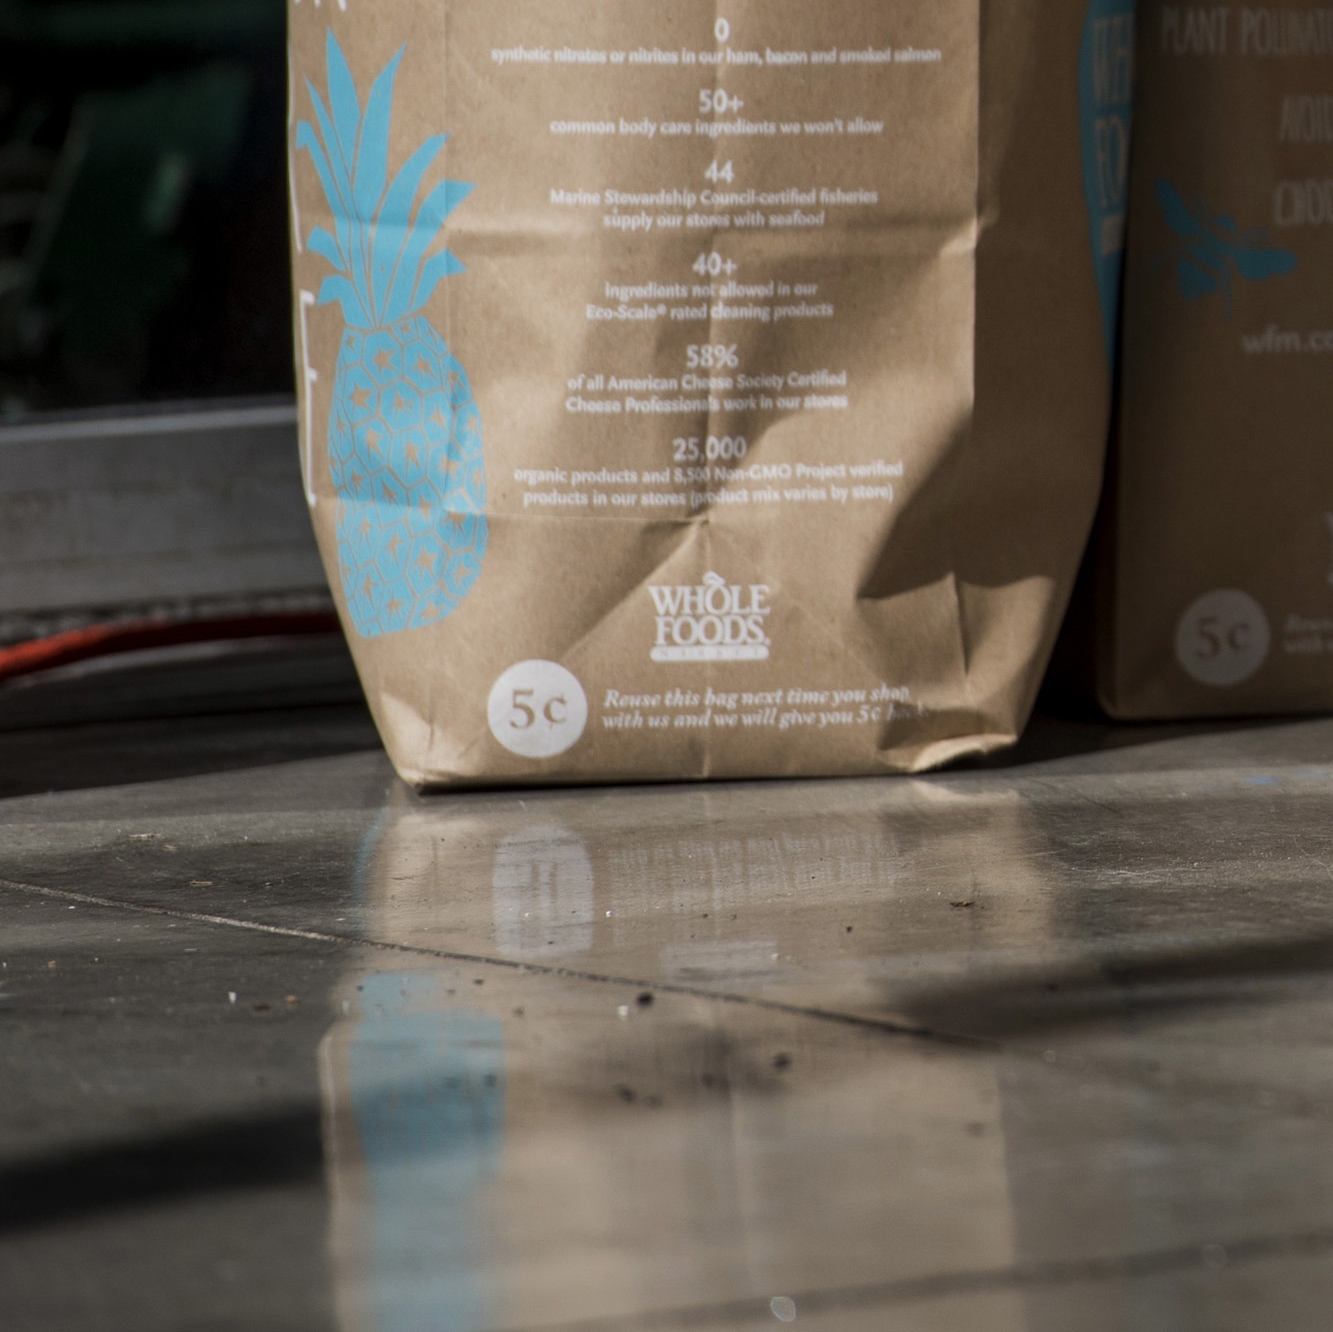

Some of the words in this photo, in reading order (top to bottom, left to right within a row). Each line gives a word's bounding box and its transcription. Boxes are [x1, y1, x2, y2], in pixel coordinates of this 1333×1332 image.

[699, 89, 744, 113] 50+
[550, 121, 615, 135] common
[619, 117, 656, 138] body
[661, 121, 691, 135] care
[696, 117, 776, 138] ingredients
[780, 120, 800, 134] we
[847, 117, 883, 134] allow
[705, 160, 734, 183] 44
[551, 188, 600, 206] Marine
[605, 188, 696, 209] Stewardship
[820, 187, 878, 205] fisheries
[604, 210, 652, 231] supply
[657, 213, 683, 227] our
[687, 210, 730, 227] stores
[734, 209, 765, 227] with
[769, 209, 824, 227] seafood
[692, 252, 738, 276] 40+
[606, 280, 687, 301] ingredients
[692, 280, 716, 297] not
[720, 279, 773, 297] allowed
[778, 279, 790, 297] in
[795, 282, 817, 296] our
[671, 302, 707, 319] rated
[711, 301, 770, 322] cleaning
[774, 300, 833, 321] products
[686, 344, 738, 368] 58%
[568, 374, 584, 391] of
[587, 373, 603, 391] all
[608, 373, 677, 390] American
[682, 372, 733, 389] Cheese
[737, 371, 784, 392] Society
[788, 370, 845, 388] Certified
[567, 395, 621, 413] Cheese
[625, 394, 719, 412] Professionals
[724, 394, 756, 411] work
[761, 393, 773, 411] in
[777, 396, 800, 410] our
[804, 392, 848, 410] stores
[673, 436, 747, 461] 25,000
[515, 465, 567, 486] organic
[571, 464, 637, 485] products
[642, 463, 669, 481] and
[796, 460, 845, 481] Project
[850, 459, 903, 477] verified
[524, 488, 588, 509] products
[593, 487, 607, 504] in
[612, 490, 636, 504] our
[641, 486, 685, 503] stores
[753, 484, 780, 502] mix
[784, 484, 826, 501] varies
[831, 483, 849, 504] by
[648, 575, 771, 615] WHOLE
[604, 688, 661, 708] Reuse
[665, 687, 700, 707] this
[705, 686, 737, 709] bag
[742, 685, 782, 705] next
[787, 684, 830, 703] time
[835, 686, 867, 706] you
[603, 709, 642, 728] with
[646, 711, 670, 727] us
[675, 707, 709, 726] and
[714, 710, 738, 726] we
[742, 705, 775, 725] will
[779, 704, 814, 727] give
[817, 707, 852, 726] you
